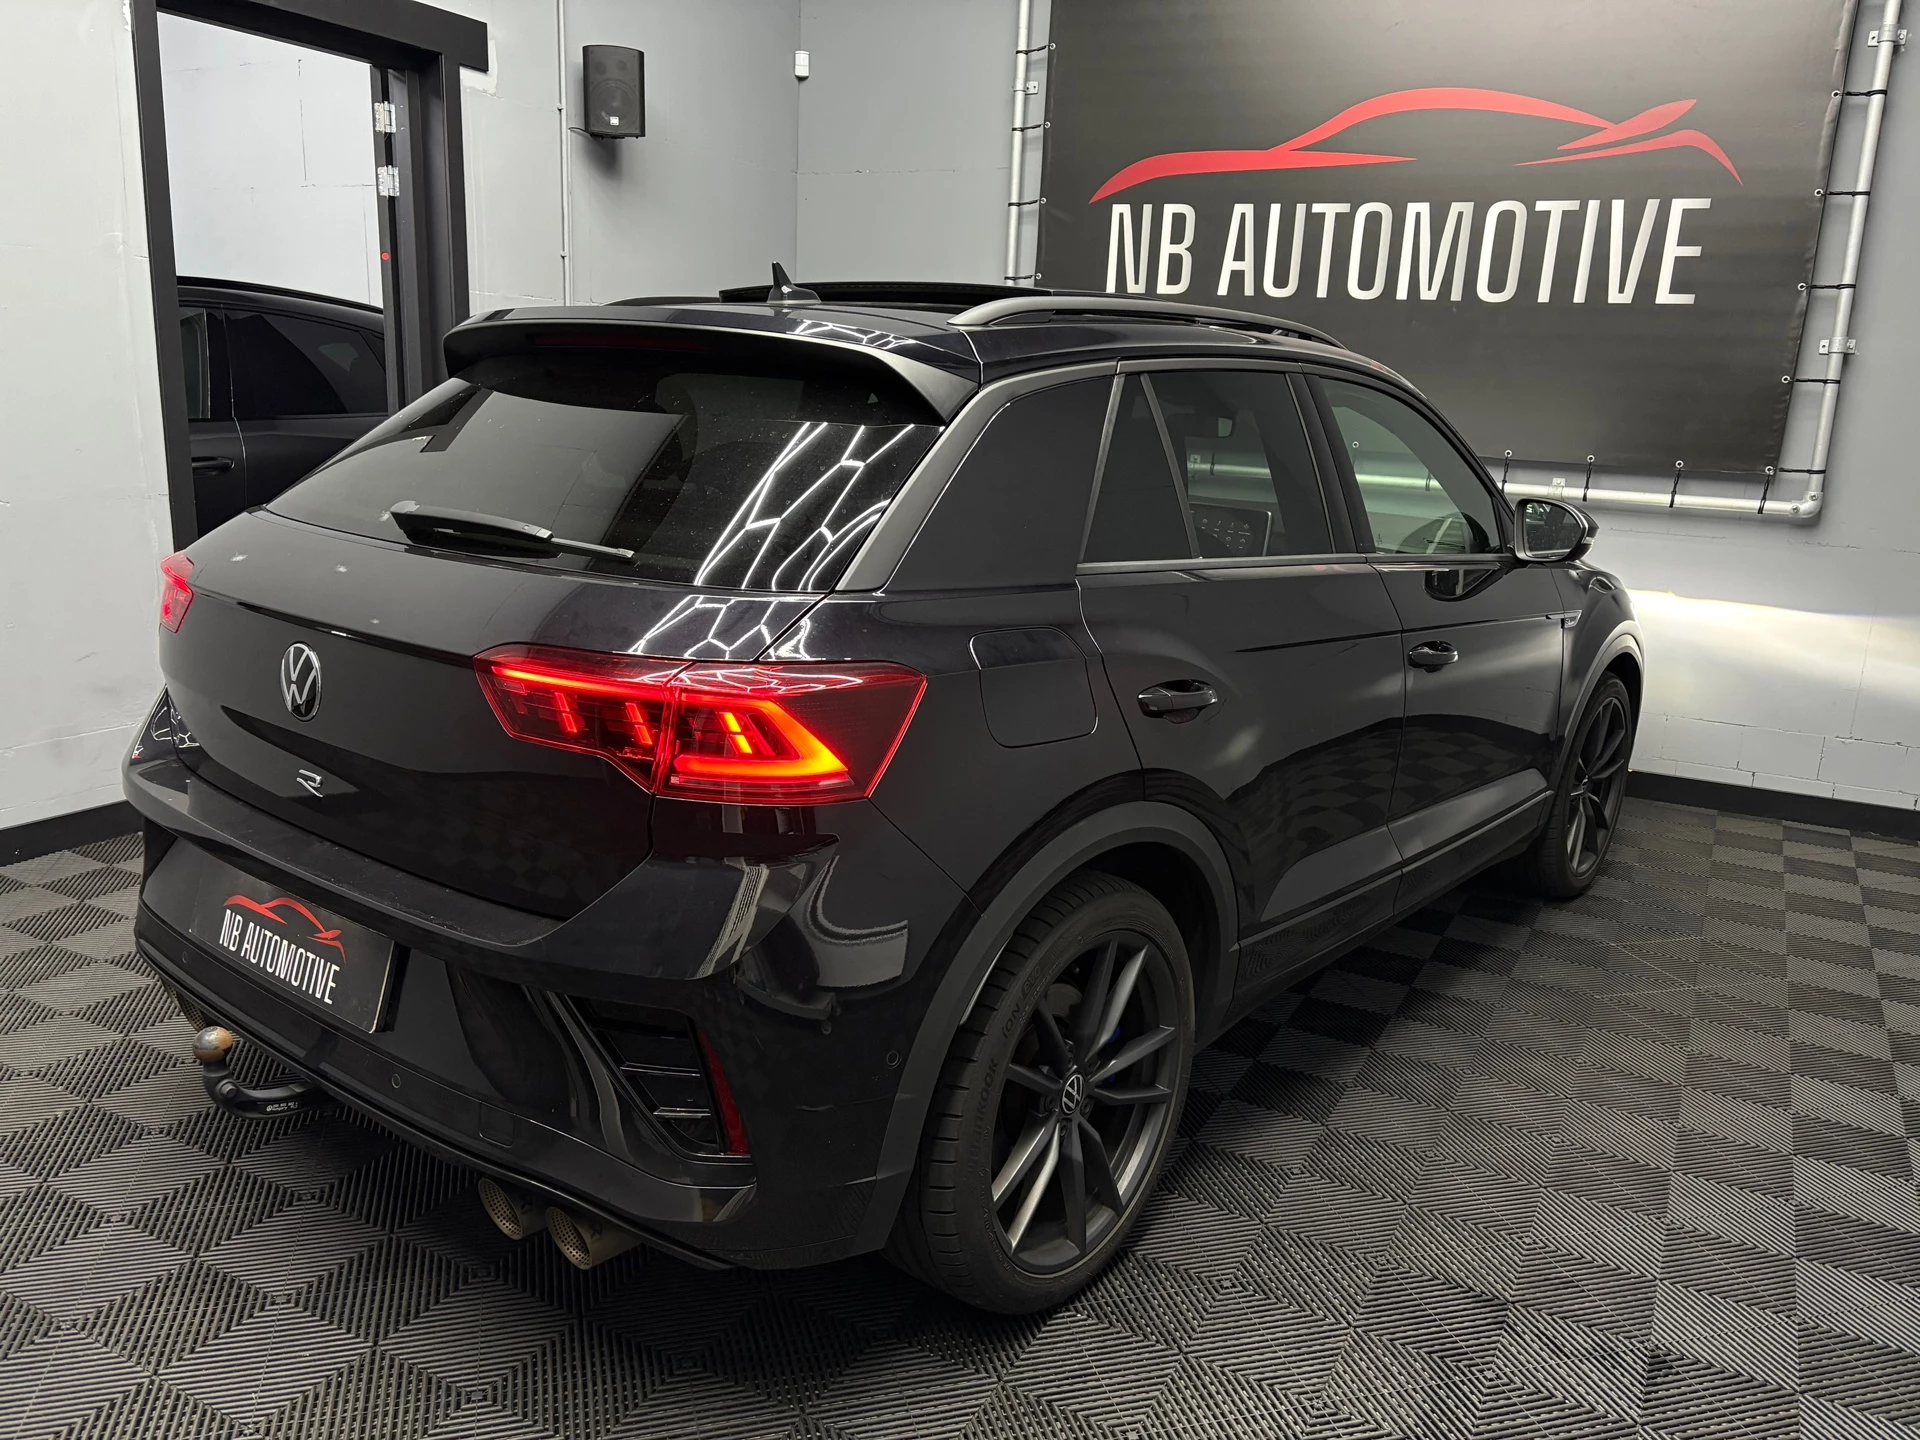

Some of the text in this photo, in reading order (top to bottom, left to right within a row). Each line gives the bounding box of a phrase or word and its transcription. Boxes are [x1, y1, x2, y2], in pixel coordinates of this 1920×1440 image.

[1106, 198, 1712, 305] NB AUTOMOTIVE
[296, 769, 324, 798] R
[219, 908, 340, 1005] NB AUTOMOTIVE
